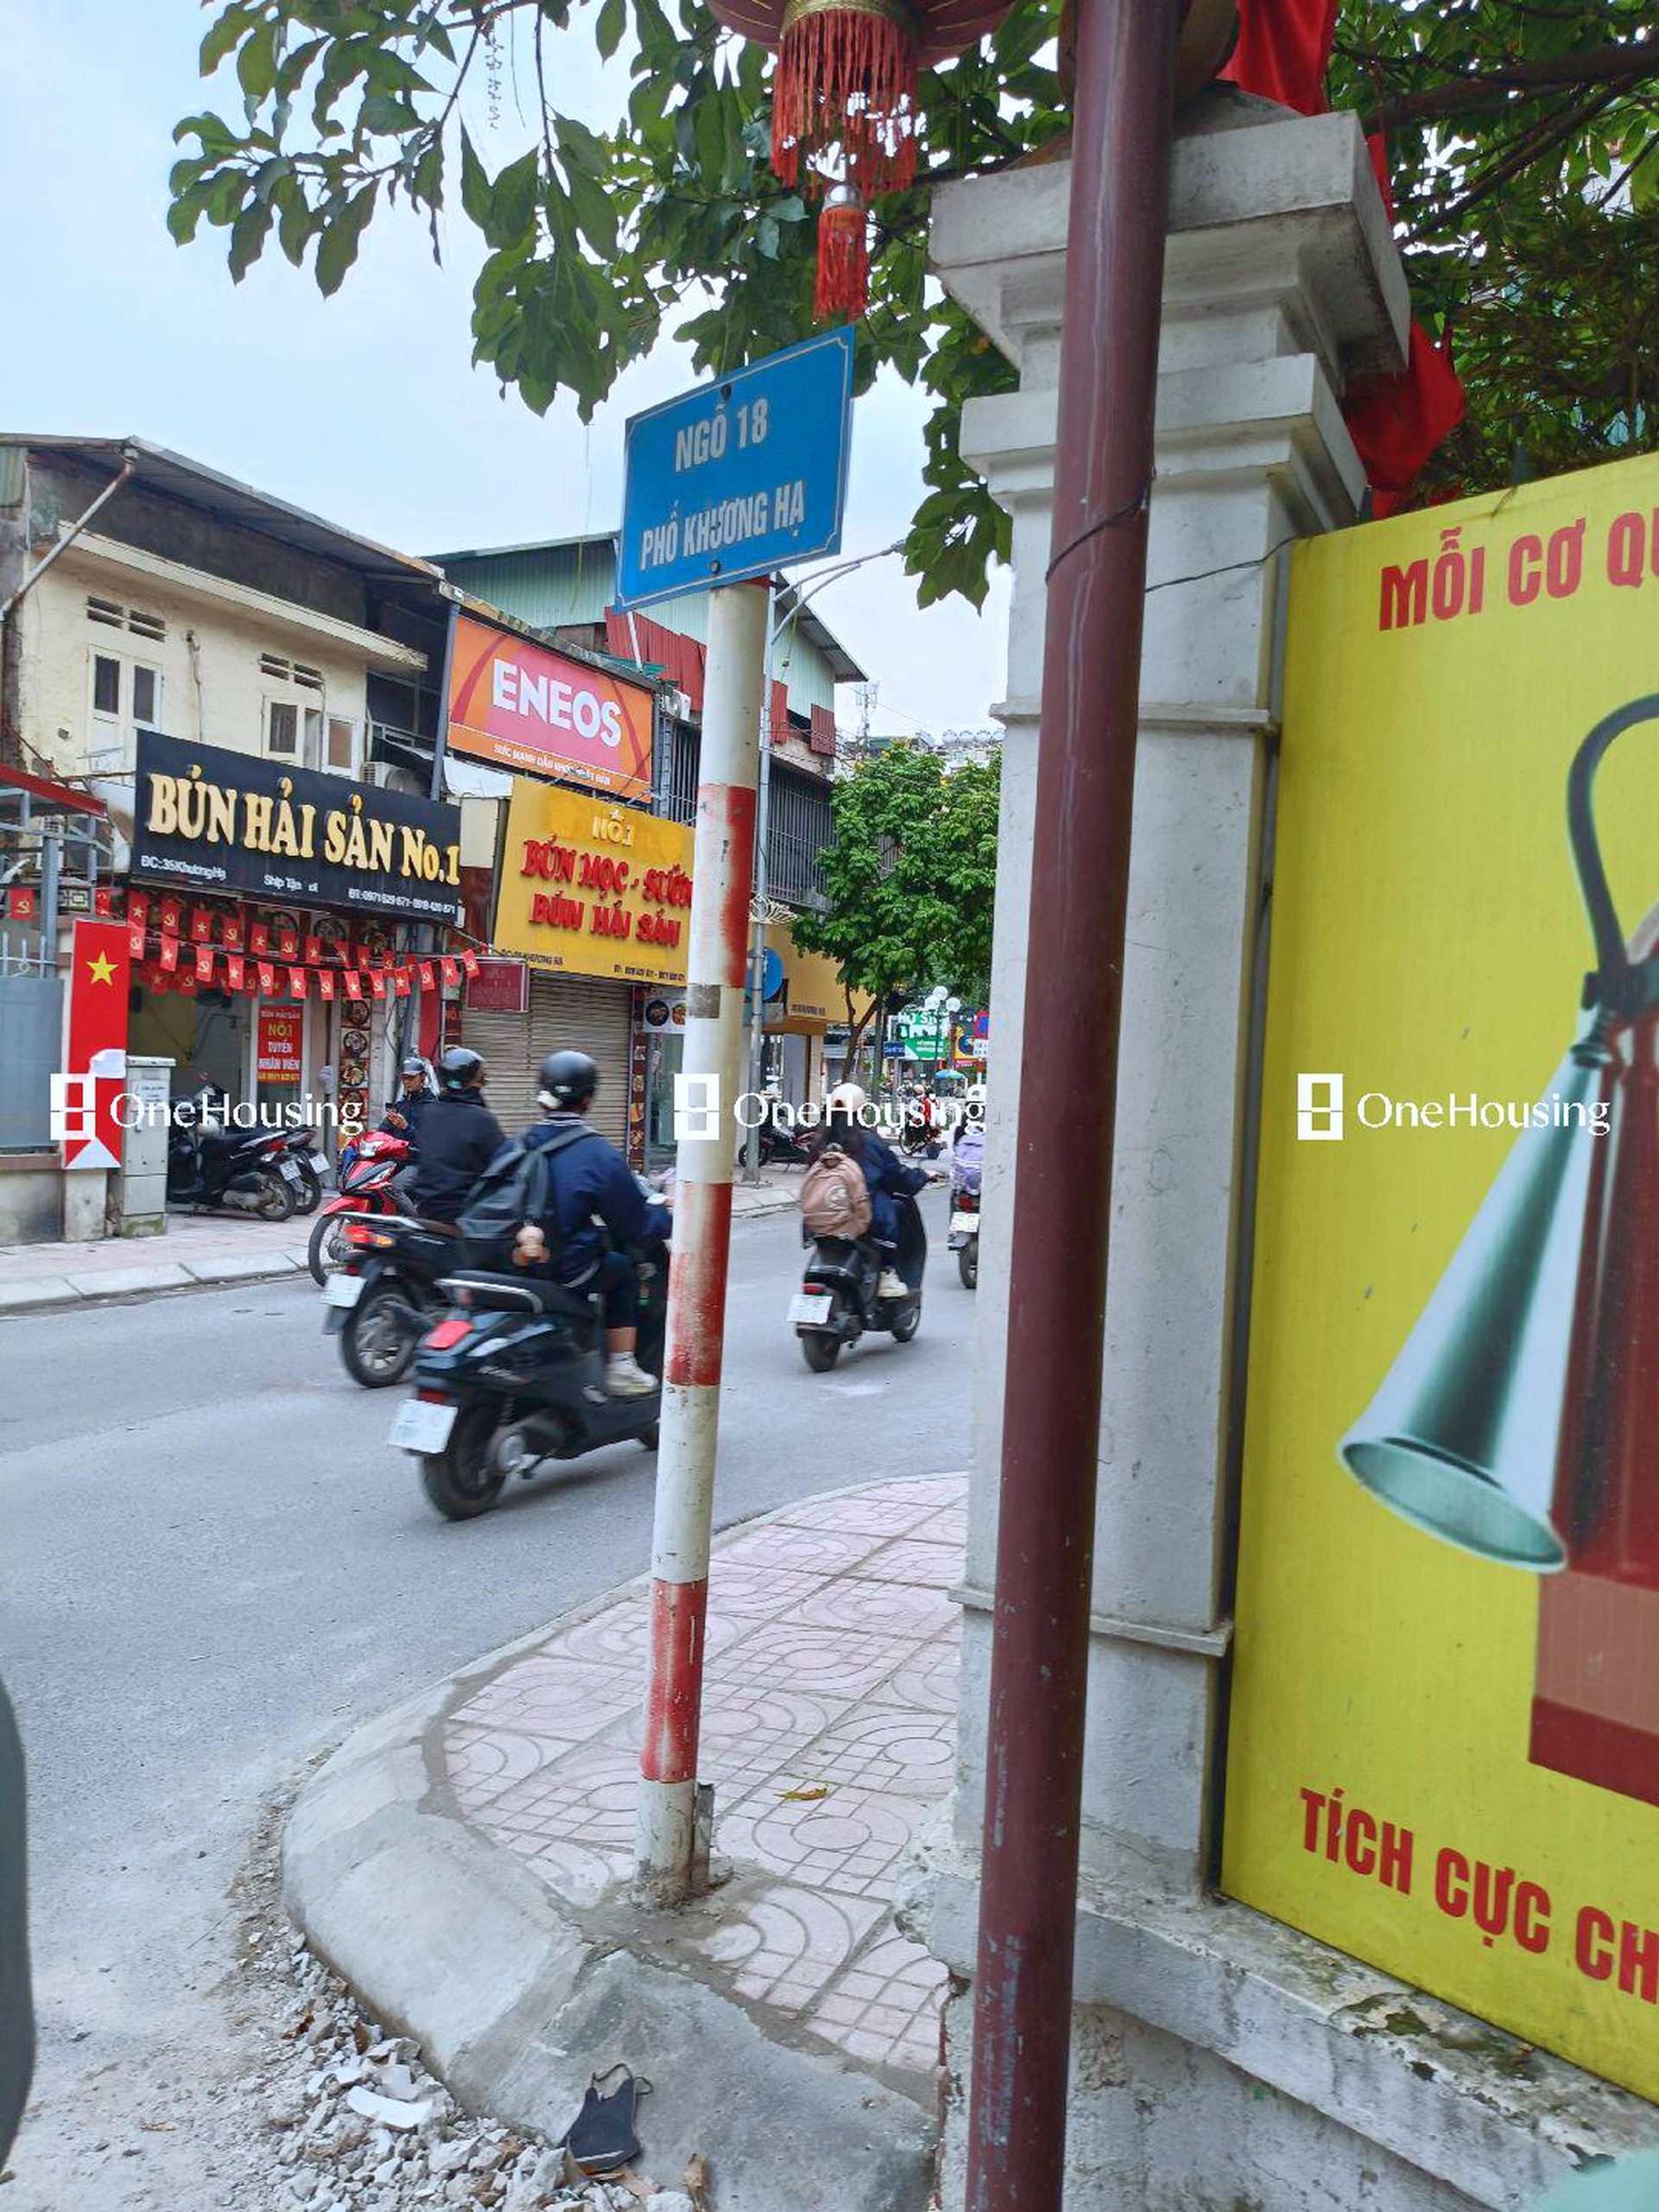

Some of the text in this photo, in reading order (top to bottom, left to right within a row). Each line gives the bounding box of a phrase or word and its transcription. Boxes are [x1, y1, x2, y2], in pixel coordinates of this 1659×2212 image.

[674, 397, 769, 472] NGÕ 18
[640, 479, 806, 571] PHỐ KHƯƠNG HẠ
[1379, 506, 1659, 631] MỖI CƠ Q
[492, 658, 622, 748] ENEOS
[243, 776, 317, 859] HẢI
[324, 794, 395, 873] SẢN
[520, 834, 577, 884] BÚN
[577, 852, 630, 900] MỌC
[529, 889, 585, 930] BÚN
[1301, 1787, 1415, 1896] TÍCH
[1435, 1847, 1552, 1955] CỰC
